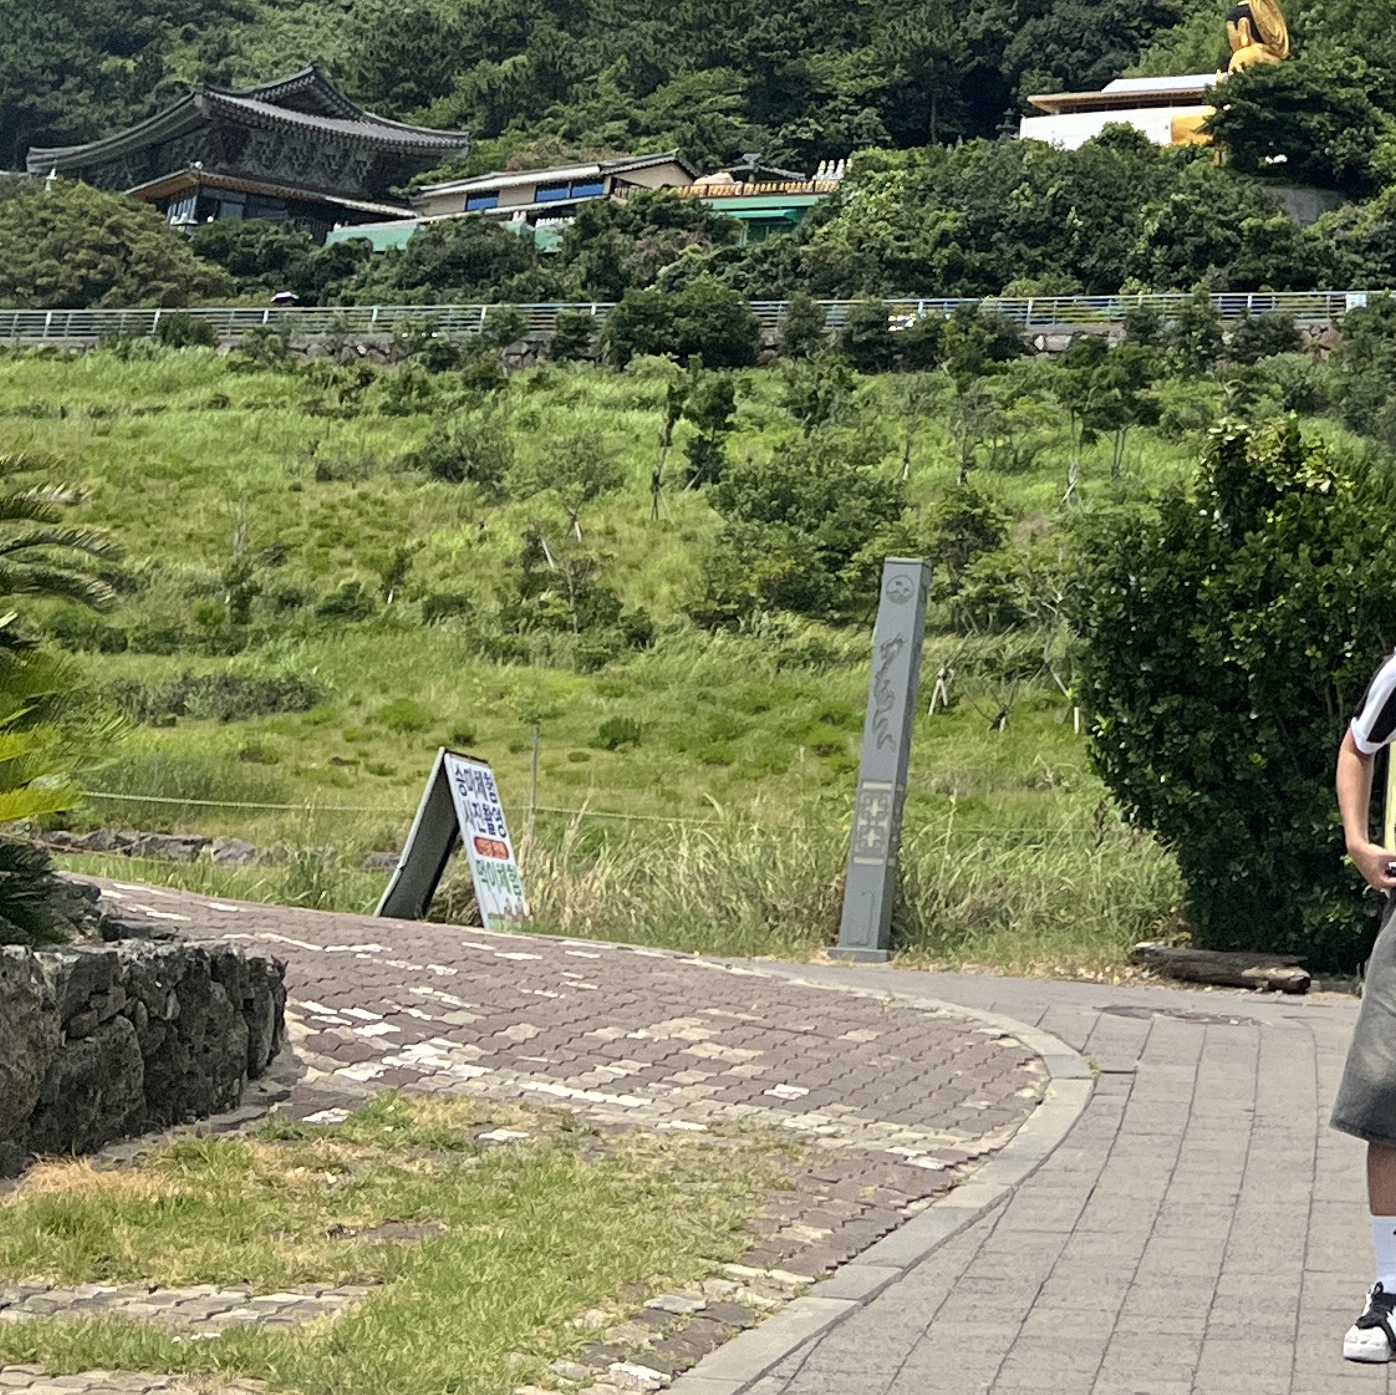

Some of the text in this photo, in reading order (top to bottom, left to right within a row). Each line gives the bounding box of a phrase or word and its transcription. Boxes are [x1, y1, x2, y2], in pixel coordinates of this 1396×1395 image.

[455, 765, 498, 804] 승마체험
[461, 800, 507, 839] 사진촬영
[475, 860, 522, 896] 먹이체험
